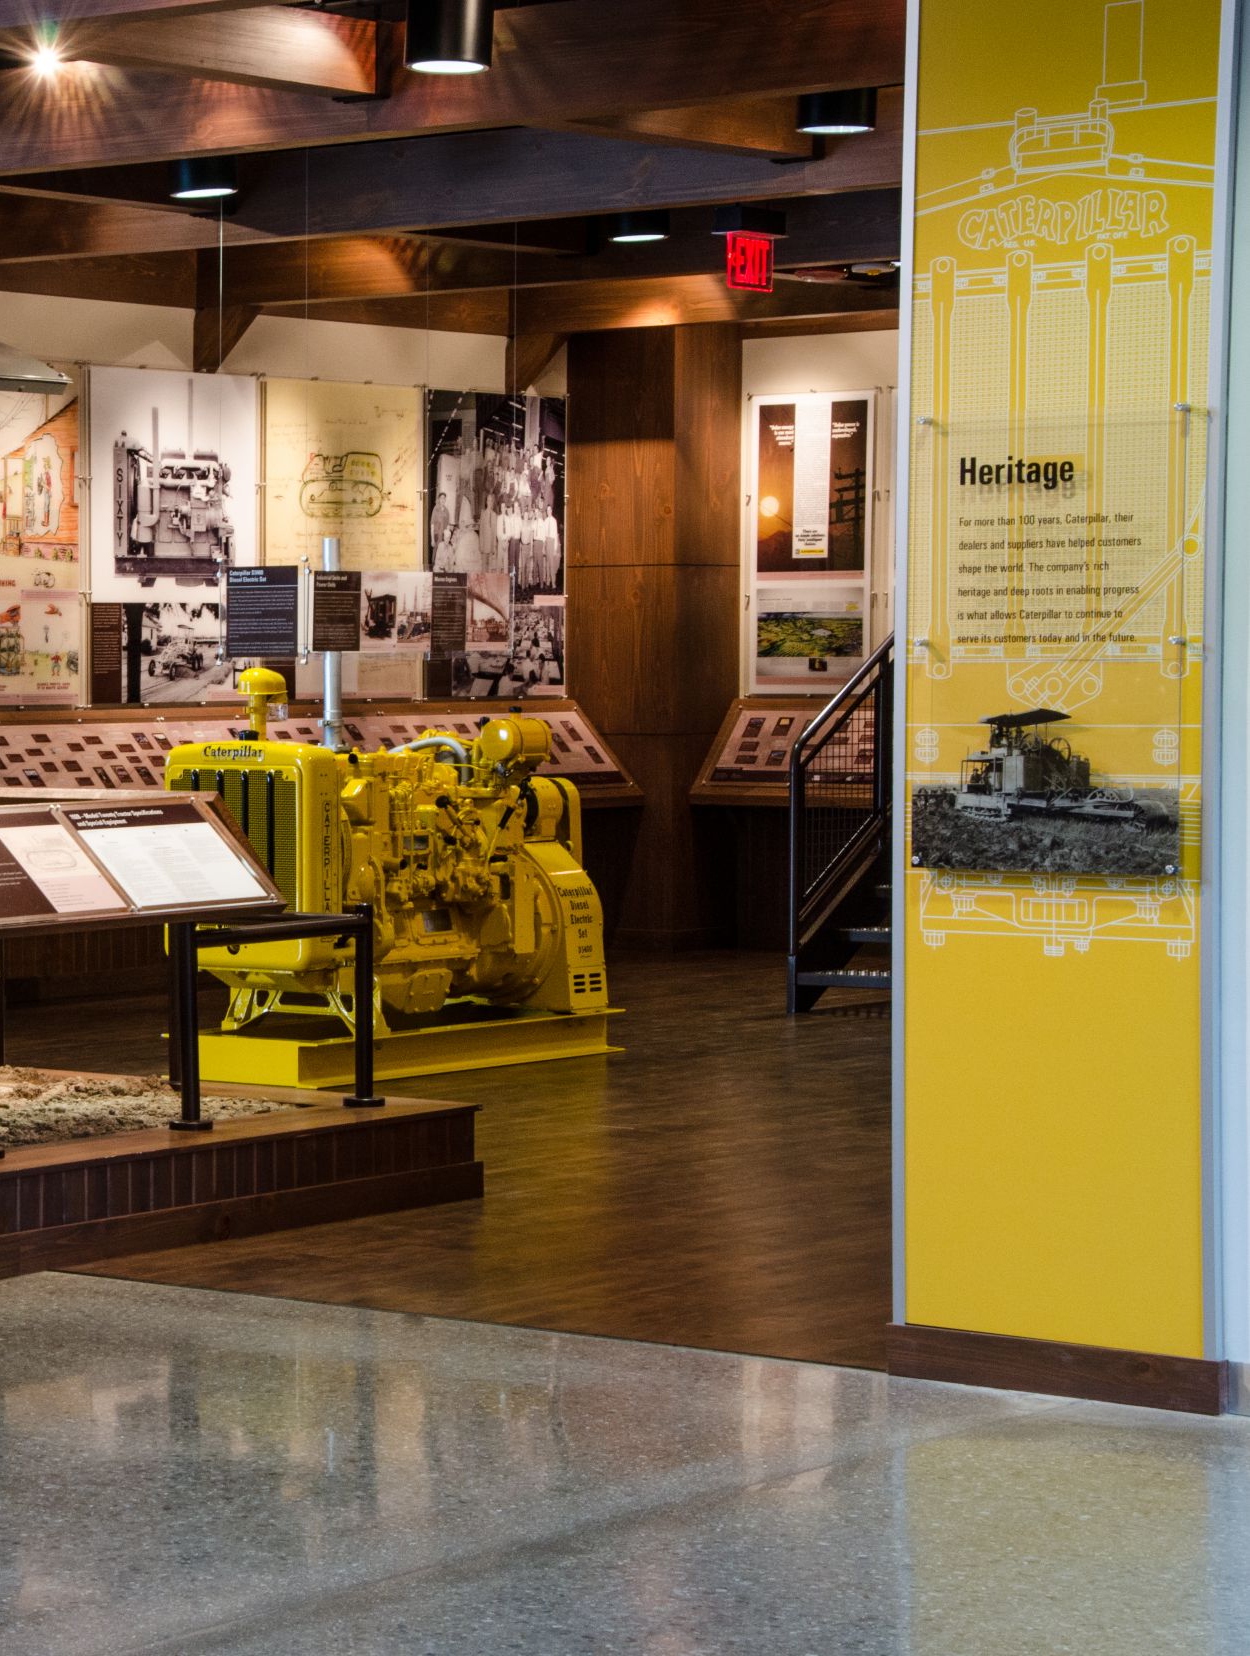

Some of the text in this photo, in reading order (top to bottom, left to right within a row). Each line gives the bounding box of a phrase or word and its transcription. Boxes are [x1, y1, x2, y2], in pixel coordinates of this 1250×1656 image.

[958, 188, 1169, 250] CATERPILLAR
[735, 237, 770, 286] EXIT
[960, 455, 1074, 490] Heritage
[116, 468, 124, 547] SIXTY
[959, 517, 971, 526] For
[998, 517, 1015, 525] than
[1020, 515, 1034, 525] 100
[1038, 517, 1062, 527] years,
[1065, 514, 1110, 525] Caterpillar,
[1115, 513, 1133, 523] their
[959, 538, 1141, 551] dealers and suppliers have helped customers
[959, 561, 1109, 574] shape the world. The company's rich
[958, 585, 1139, 598] heritage and deep roots in enabling progress
[958, 612, 964, 620] is
[967, 611, 987, 620] what
[990, 611, 1016, 619] allows
[1020, 610, 1061, 620] Caterpillar
[1076, 610, 1111, 618] continue
[1115, 610, 1122, 618] to
[982, 634, 991, 643] its
[994, 634, 1036, 643] customers
[1039, 634, 1061, 644] today
[1065, 633, 1080, 642] and
[1083, 633, 1089, 641] in
[1093, 633, 1105, 641] the
[1110, 633, 1136, 642] future.
[204, 746, 263, 761] Caterpillar
[570, 900, 589, 910] Diesel
[570, 914, 593, 925] Electric
[578, 928, 588, 939] Set
